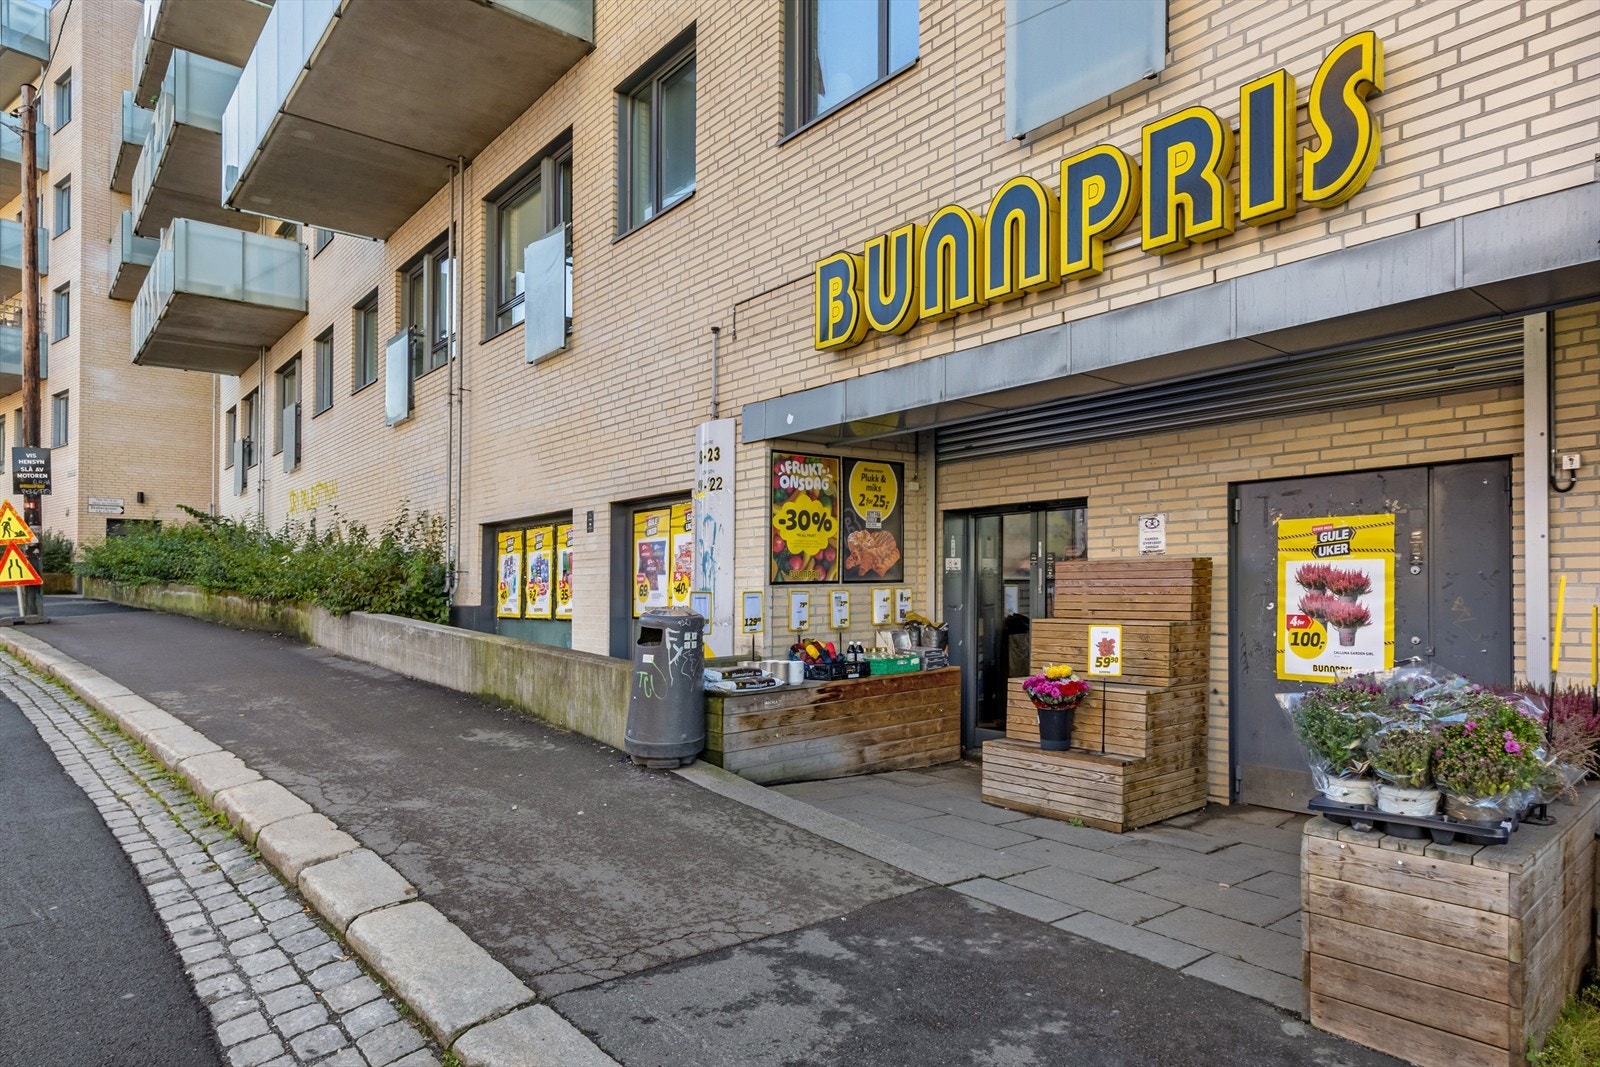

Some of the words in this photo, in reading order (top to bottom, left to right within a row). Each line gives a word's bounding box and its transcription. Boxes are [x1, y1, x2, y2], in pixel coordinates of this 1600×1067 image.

[815, 30, 1384, 351] BUNNPRIS
[779, 475, 829, 490] ONSDAG
[861, 473, 879, 482] Plukk
[881, 475, 886, 483] &
[778, 509, 832, 532] -30%
[1319, 528, 1350, 542] GULE
[1318, 543, 1349, 556] UKER
[1290, 631, 1325, 650] 100,-
